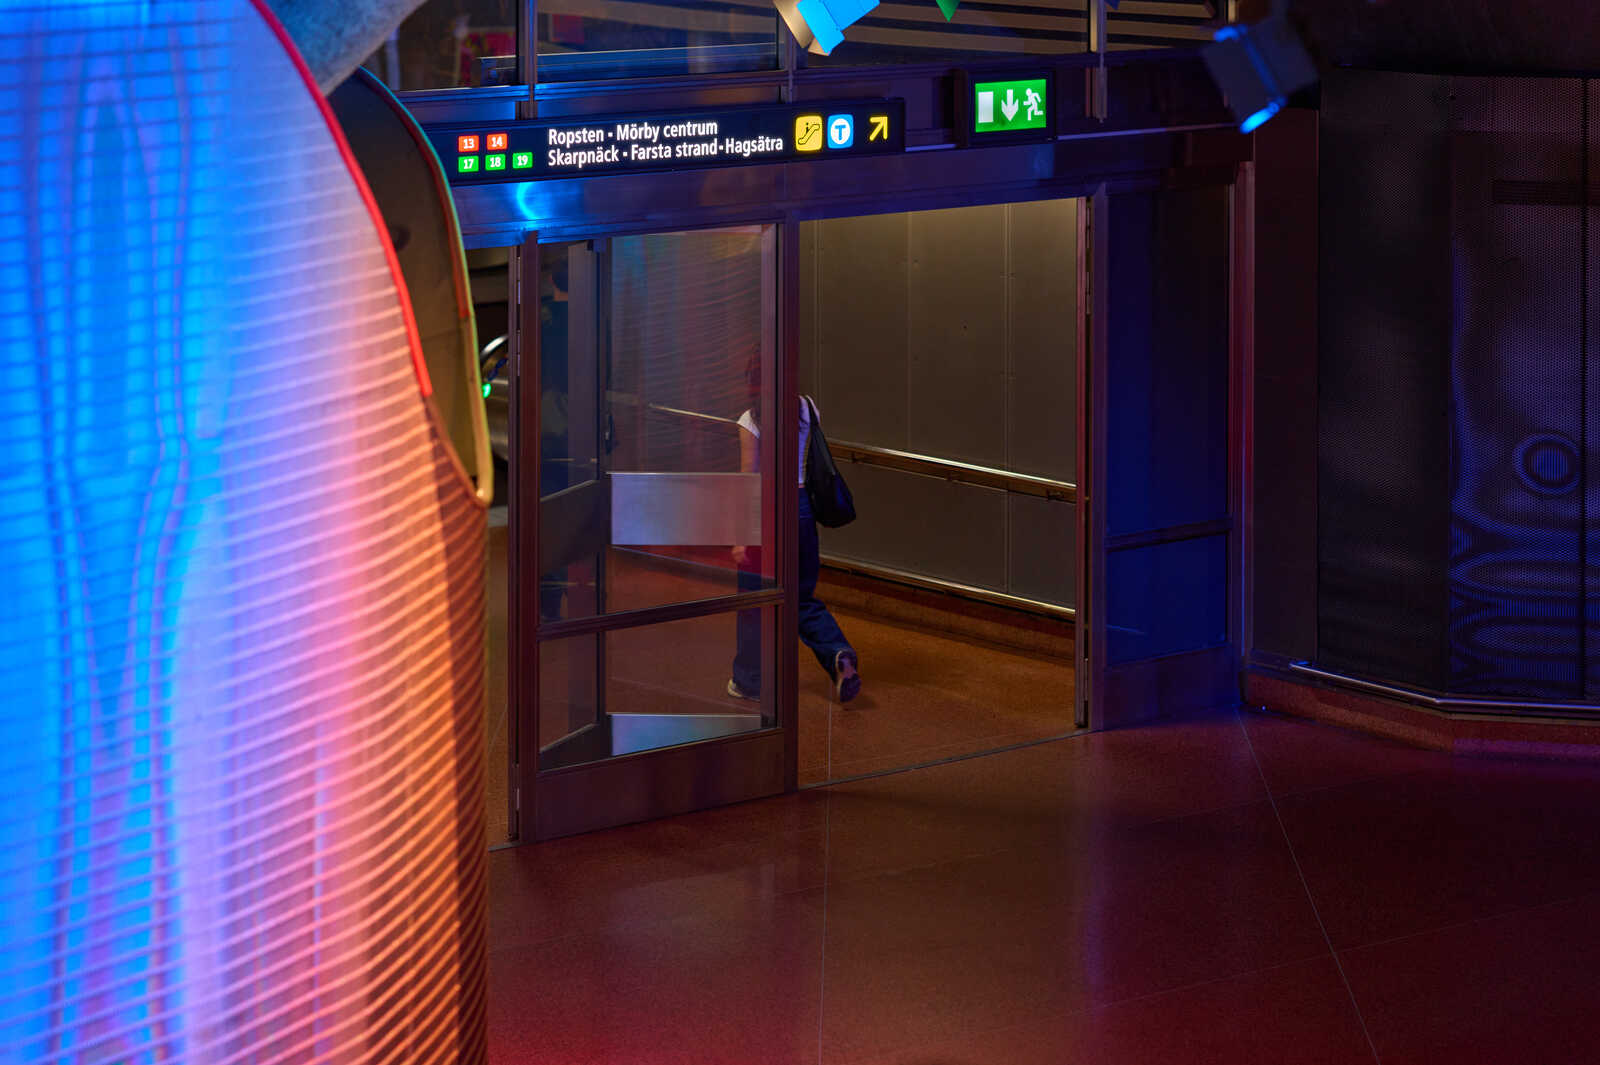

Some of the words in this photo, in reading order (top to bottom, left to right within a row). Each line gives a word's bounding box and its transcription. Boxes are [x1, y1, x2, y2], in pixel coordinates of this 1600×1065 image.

[462, 137, 476, 150] 13
[491, 135, 504, 148] 14
[547, 127, 605, 149] Ropsten
[616, 121, 661, 144] Mörby
[663, 120, 719, 138] centrum
[463, 158, 475, 170] 17
[489, 156, 502, 168] 18
[516, 154, 529, 167] 19
[547, 145, 620, 169] Skarpnäck
[630, 143, 673, 161] Farsta
[675, 138, 719, 158] strand
[725, 135, 784, 158] Hagsätra
